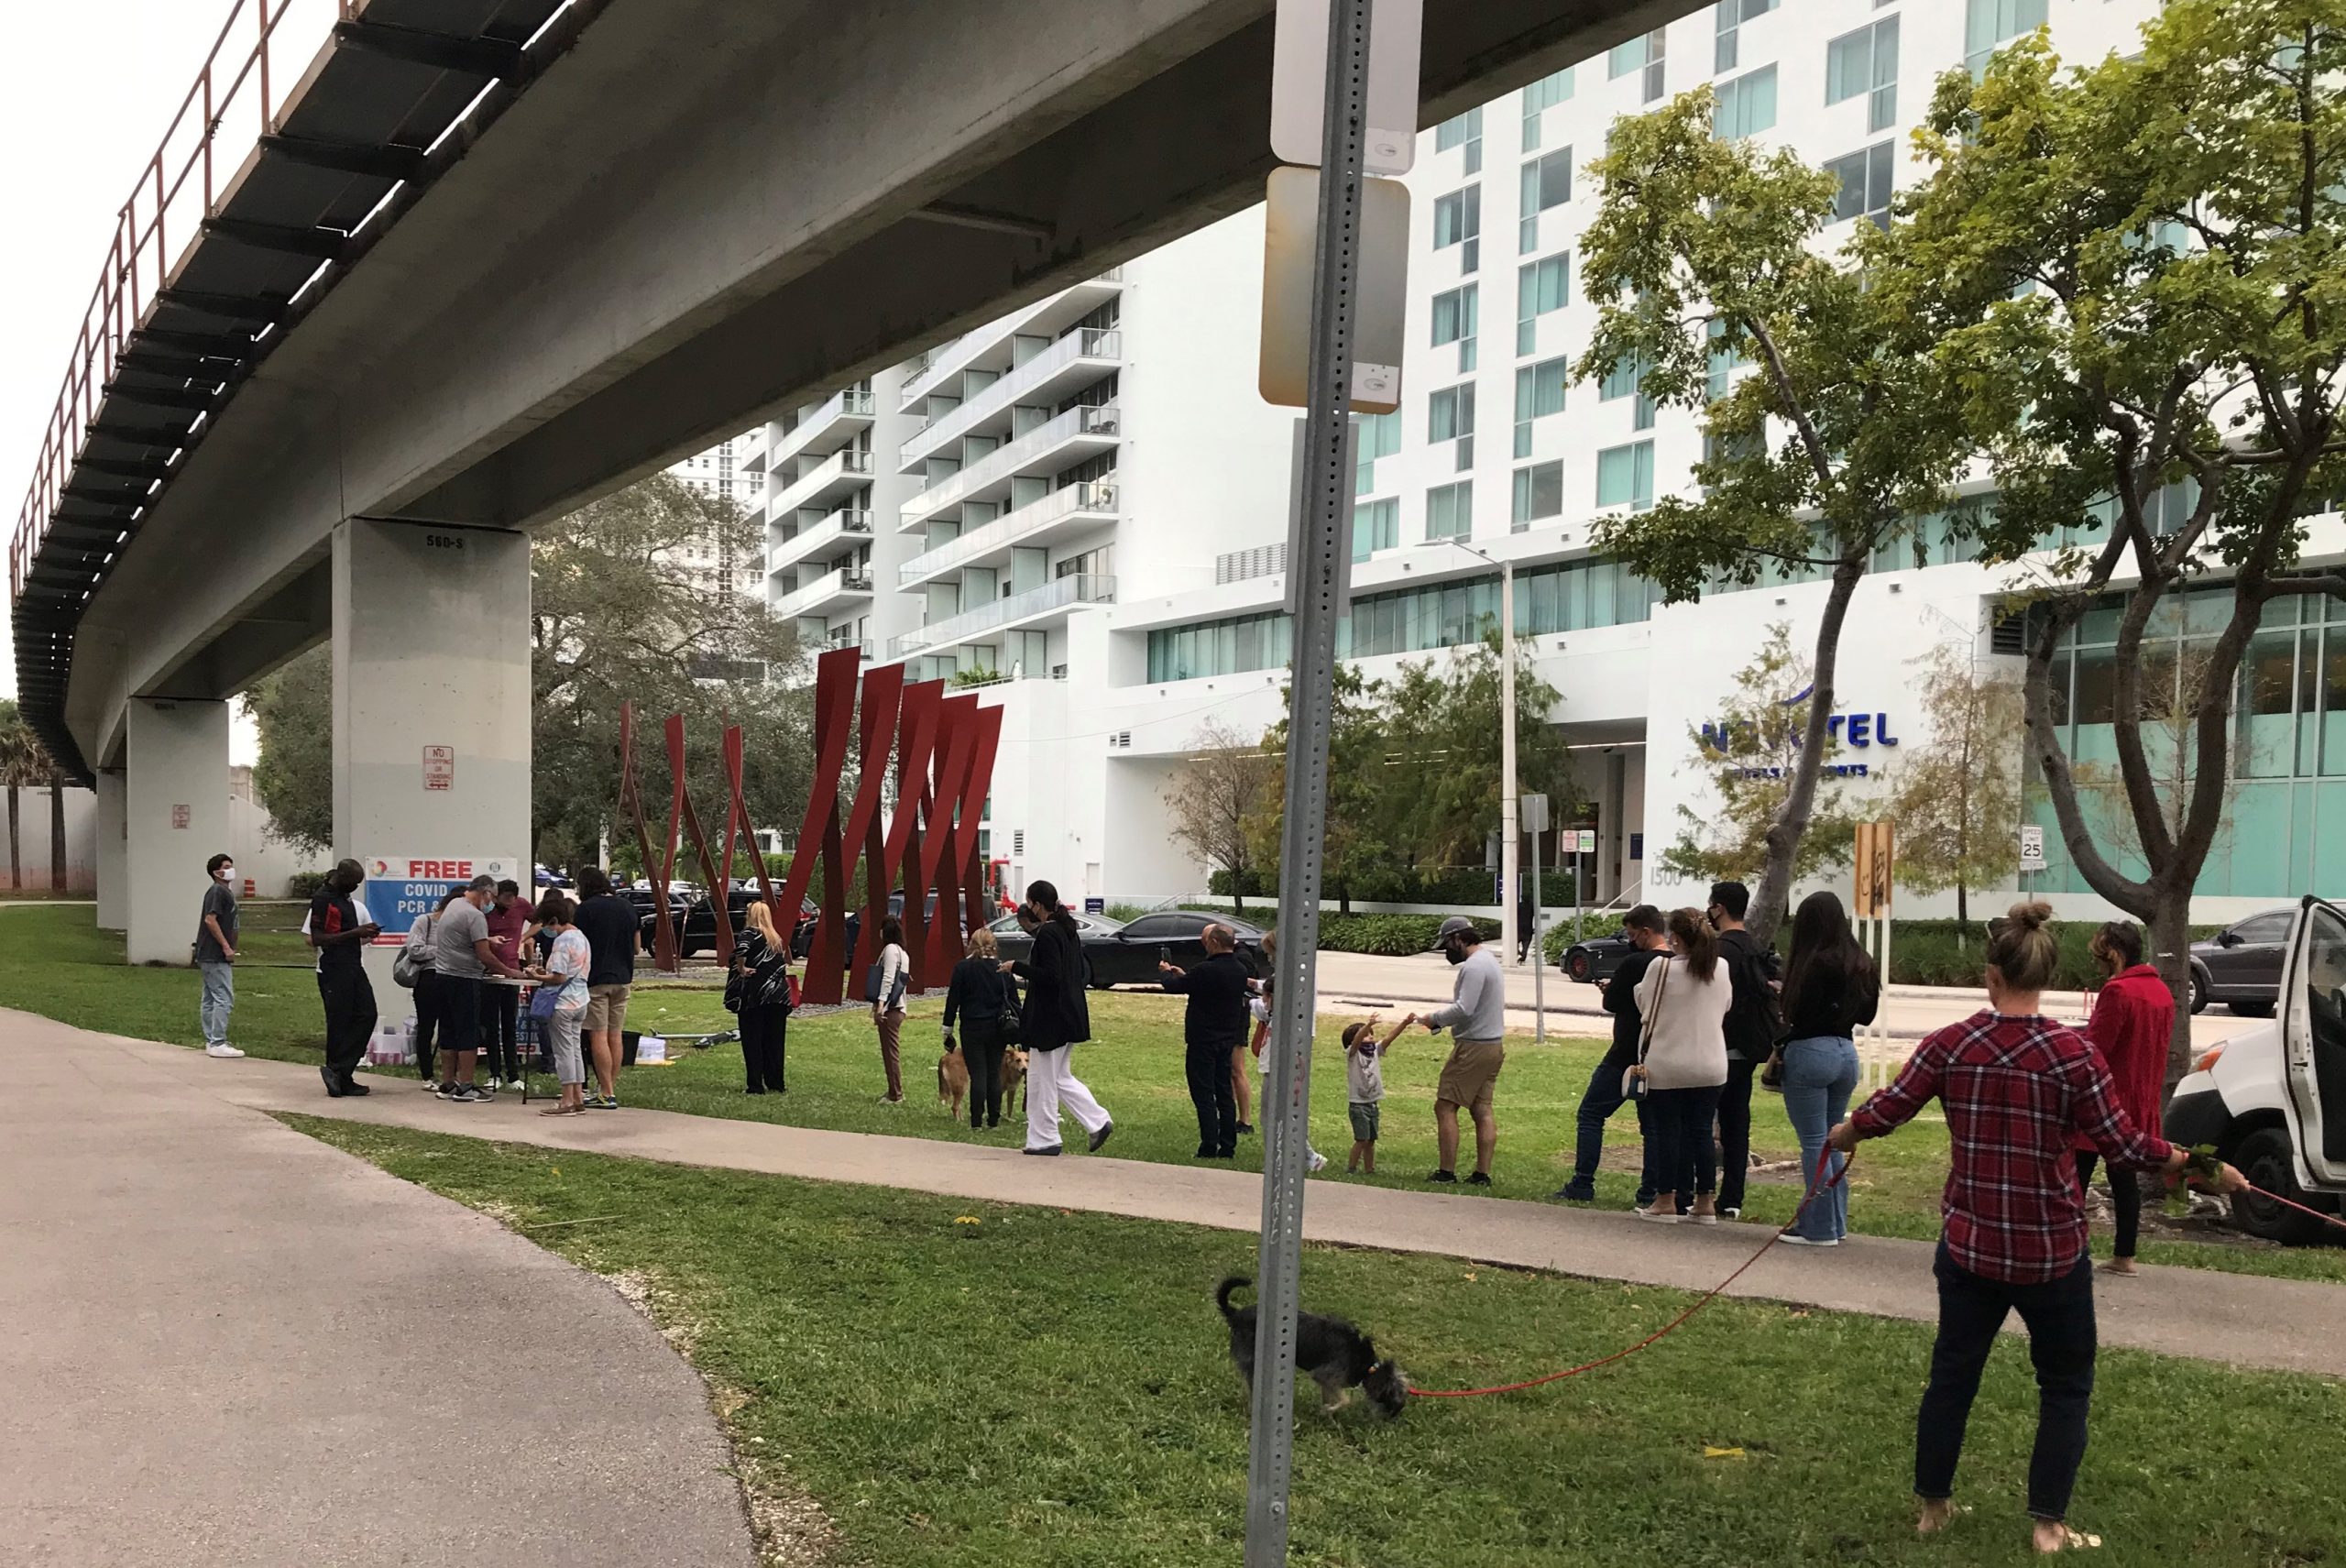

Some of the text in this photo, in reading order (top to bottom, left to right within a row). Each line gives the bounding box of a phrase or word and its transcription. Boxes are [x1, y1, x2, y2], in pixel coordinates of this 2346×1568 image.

[433, 748, 444, 758] NO
[2023, 843, 2041, 857] 25
[409, 860, 473, 879] FREE
[405, 883, 448, 897] COVID
[398, 900, 426, 913] PCR
